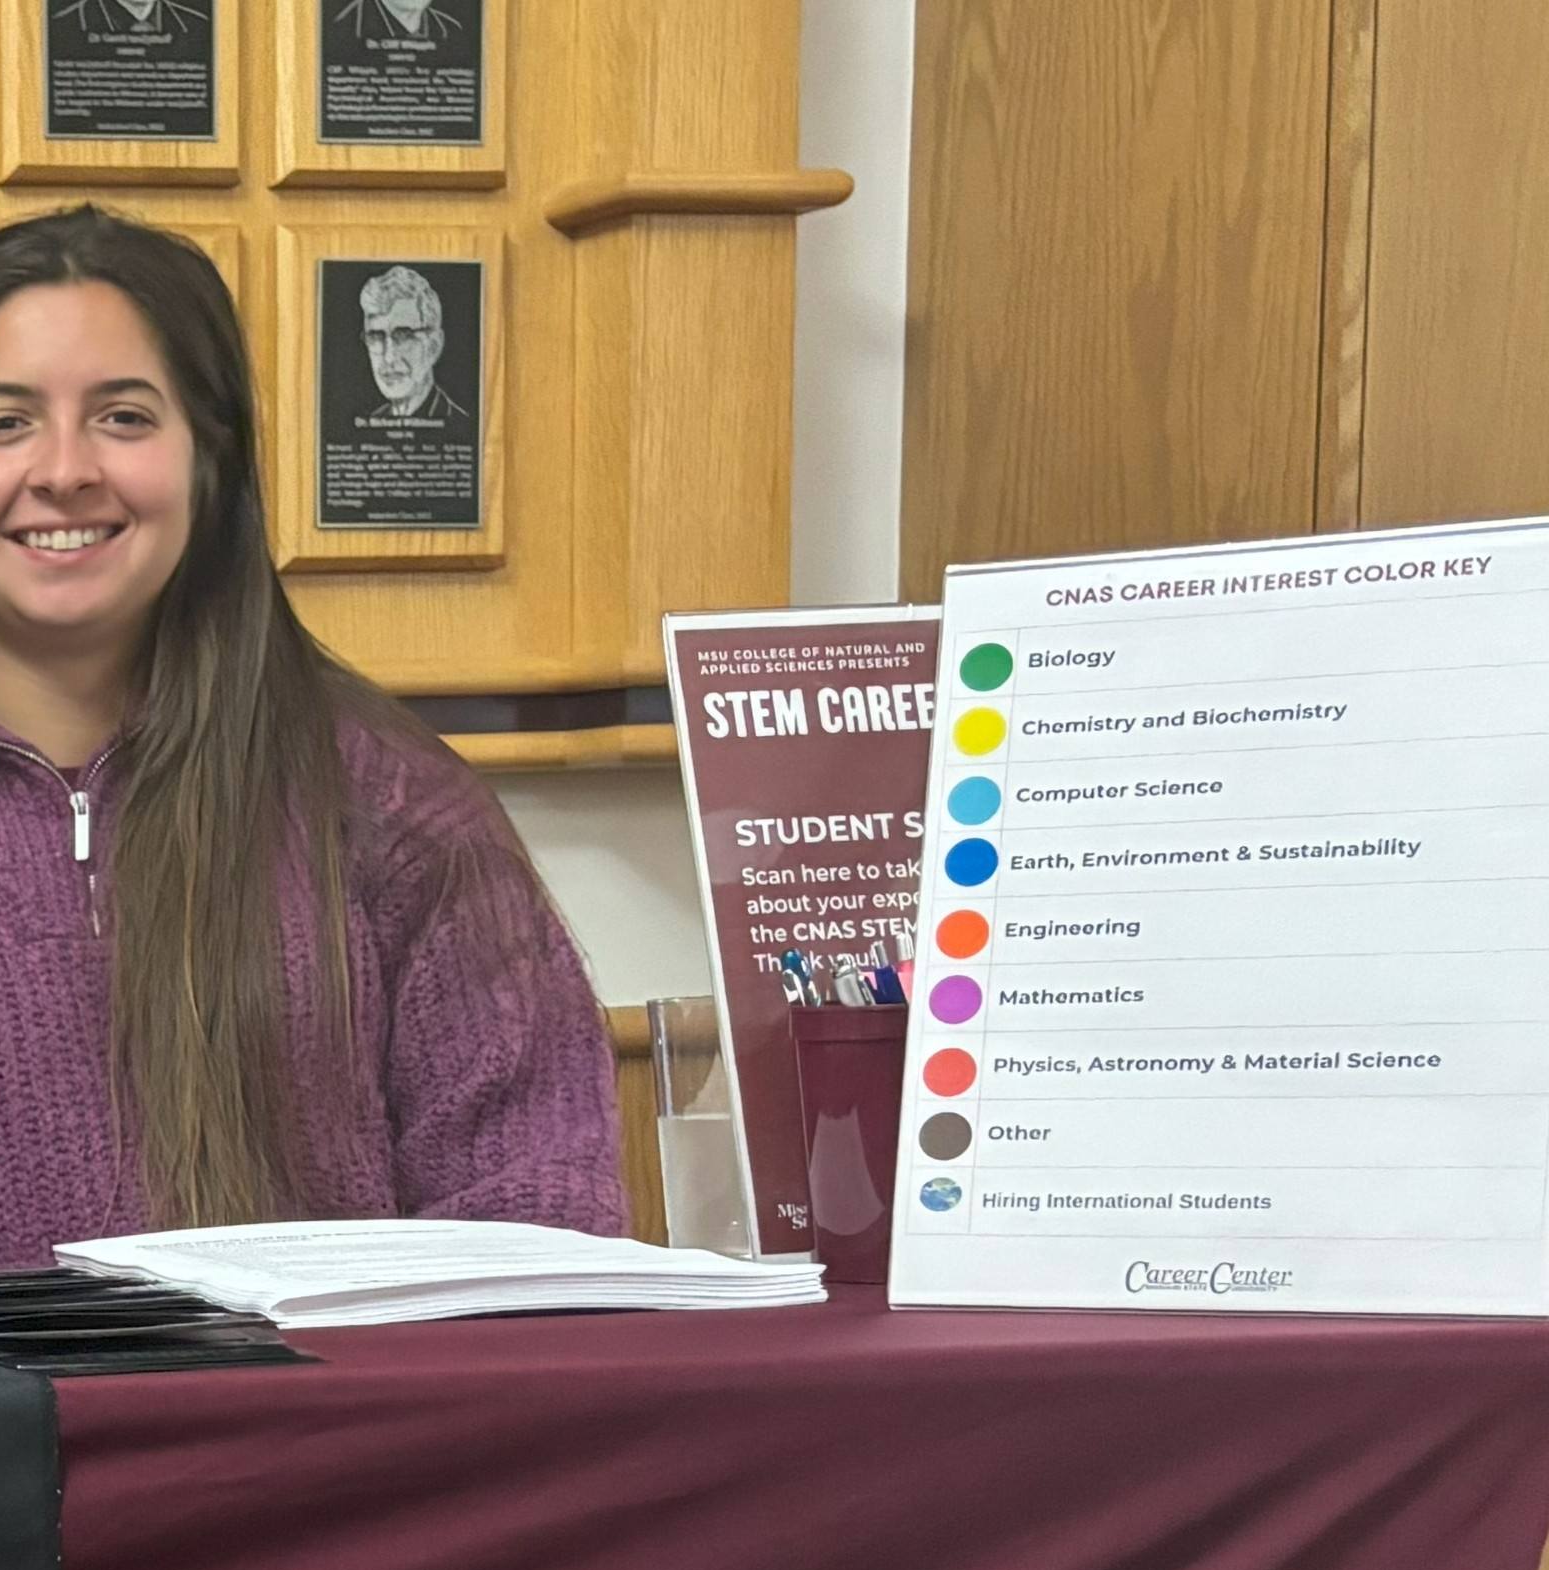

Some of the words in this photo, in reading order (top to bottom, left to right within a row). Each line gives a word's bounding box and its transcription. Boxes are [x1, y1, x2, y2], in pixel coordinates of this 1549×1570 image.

[1045, 585, 1114, 607] CNAS
[1120, 579, 1216, 602] CAREER
[1222, 567, 1339, 595] INTEREST
[1343, 560, 1436, 585] COLOR
[1443, 555, 1492, 577] KEY
[698, 652, 728, 661] MSU
[734, 649, 796, 660] COLLEGE
[802, 647, 819, 658] OF
[825, 645, 890, 656] NATURAL
[896, 643, 924, 653] AND
[1028, 649, 1116, 668] Biology
[701, 664, 760, 675] APPLIED
[766, 660, 833, 673] SCIENCES
[839, 657, 910, 669] PRESENTS
[704, 689, 808, 738] STEM
[1021, 715, 1137, 736] Chemistry
[1141, 710, 1186, 729] and
[1192, 703, 1348, 726] Biochemistry
[1016, 784, 1129, 804] Computer
[1134, 779, 1223, 797] Science
[735, 813, 893, 846] STUDENT
[1010, 853, 1075, 871] Earth,
[1082, 847, 1230, 868] Environment
[1236, 845, 1252, 861] &
[1258, 837, 1422, 861] Sustainability
[742, 867, 795, 886] Scan
[801, 864, 852, 883] here
[857, 865, 880, 880] to
[747, 896, 811, 915] about
[817, 896, 866, 915] your
[750, 925, 787, 943] the
[793, 922, 856, 941] CNAS
[1005, 918, 1141, 941] Engineering
[999, 986, 1144, 1006] Mathematics
[993, 1055, 1082, 1077] Physics,
[1087, 1056, 1215, 1074] Astronomy
[1220, 1054, 1237, 1070] &
[1244, 1051, 1340, 1070] Material
[1346, 1051, 1442, 1069] Science
[988, 1124, 1052, 1141] Other
[982, 1192, 1041, 1212] Hiring
[1046, 1193, 1174, 1209] International
[1178, 1193, 1272, 1210] Students
[1126, 1261, 1208, 1293] Career
[1210, 1262, 1292, 1294] Center
